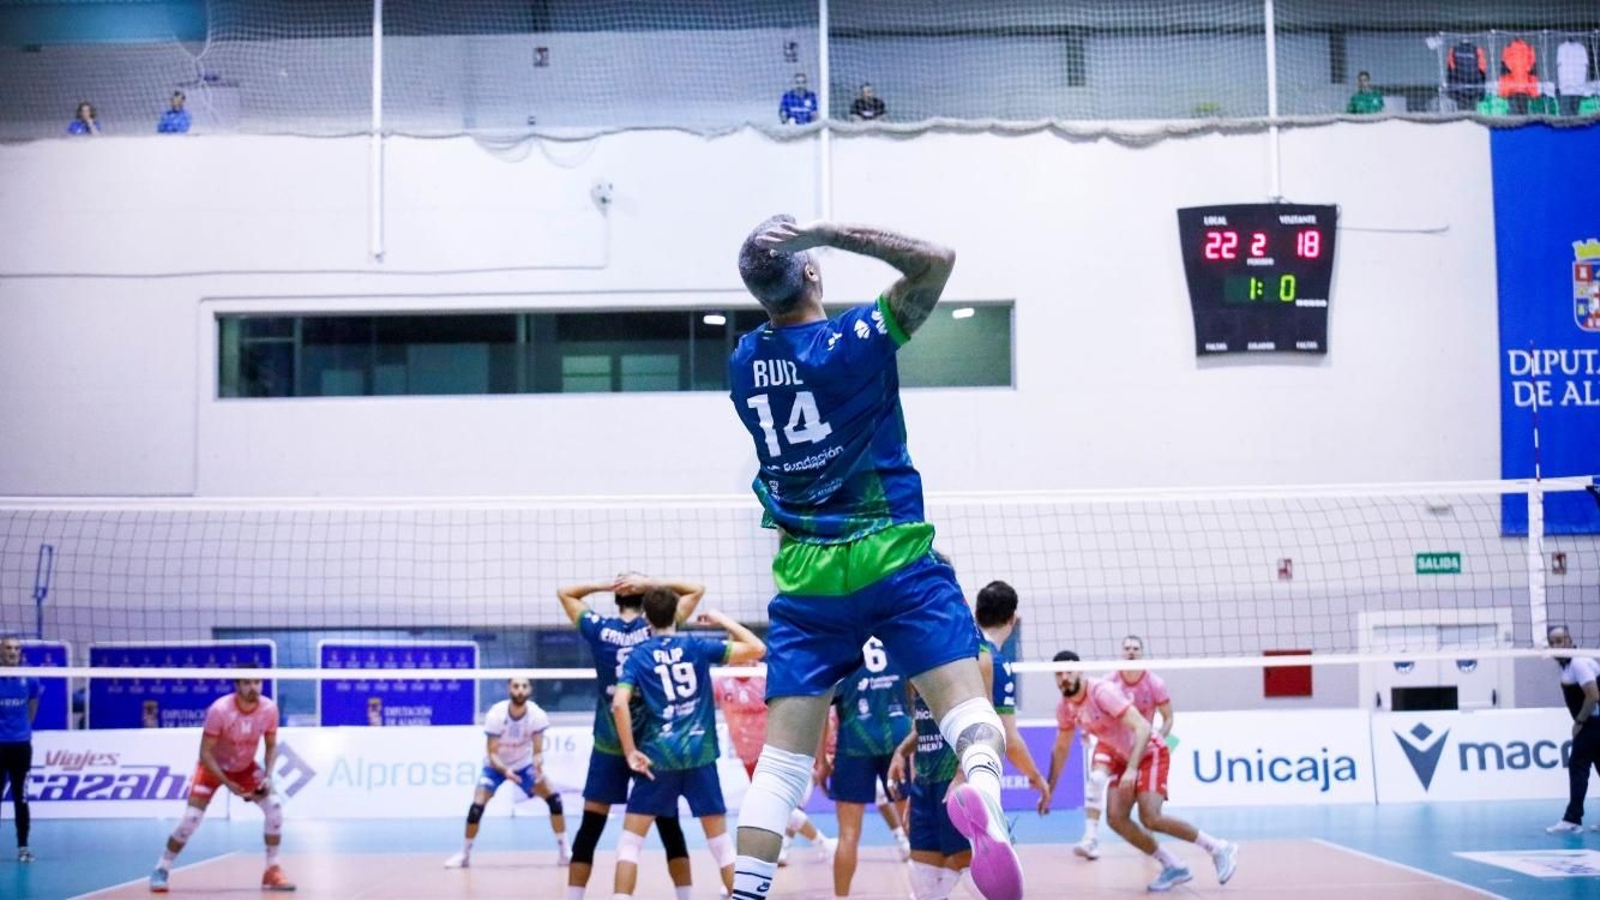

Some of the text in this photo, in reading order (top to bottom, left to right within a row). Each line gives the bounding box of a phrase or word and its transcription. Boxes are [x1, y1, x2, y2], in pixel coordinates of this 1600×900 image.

[1205, 231, 1238, 259] 22
[1251, 233, 1266, 256] 2
[1297, 230, 1320, 257] 18
[753, 359, 804, 388] RUIZ
[1512, 380, 1600, 407] DE AL
[747, 391, 832, 457] 14
[1417, 556, 1459, 570] SALIDA
[862, 635, 888, 672] 6
[654, 661, 698, 702] 19
[44, 749, 119, 771] Viajes
[1193, 747, 1357, 792] Unicaja
[1458, 739, 1572, 772] macr
[326, 756, 478, 793] Alprosa
